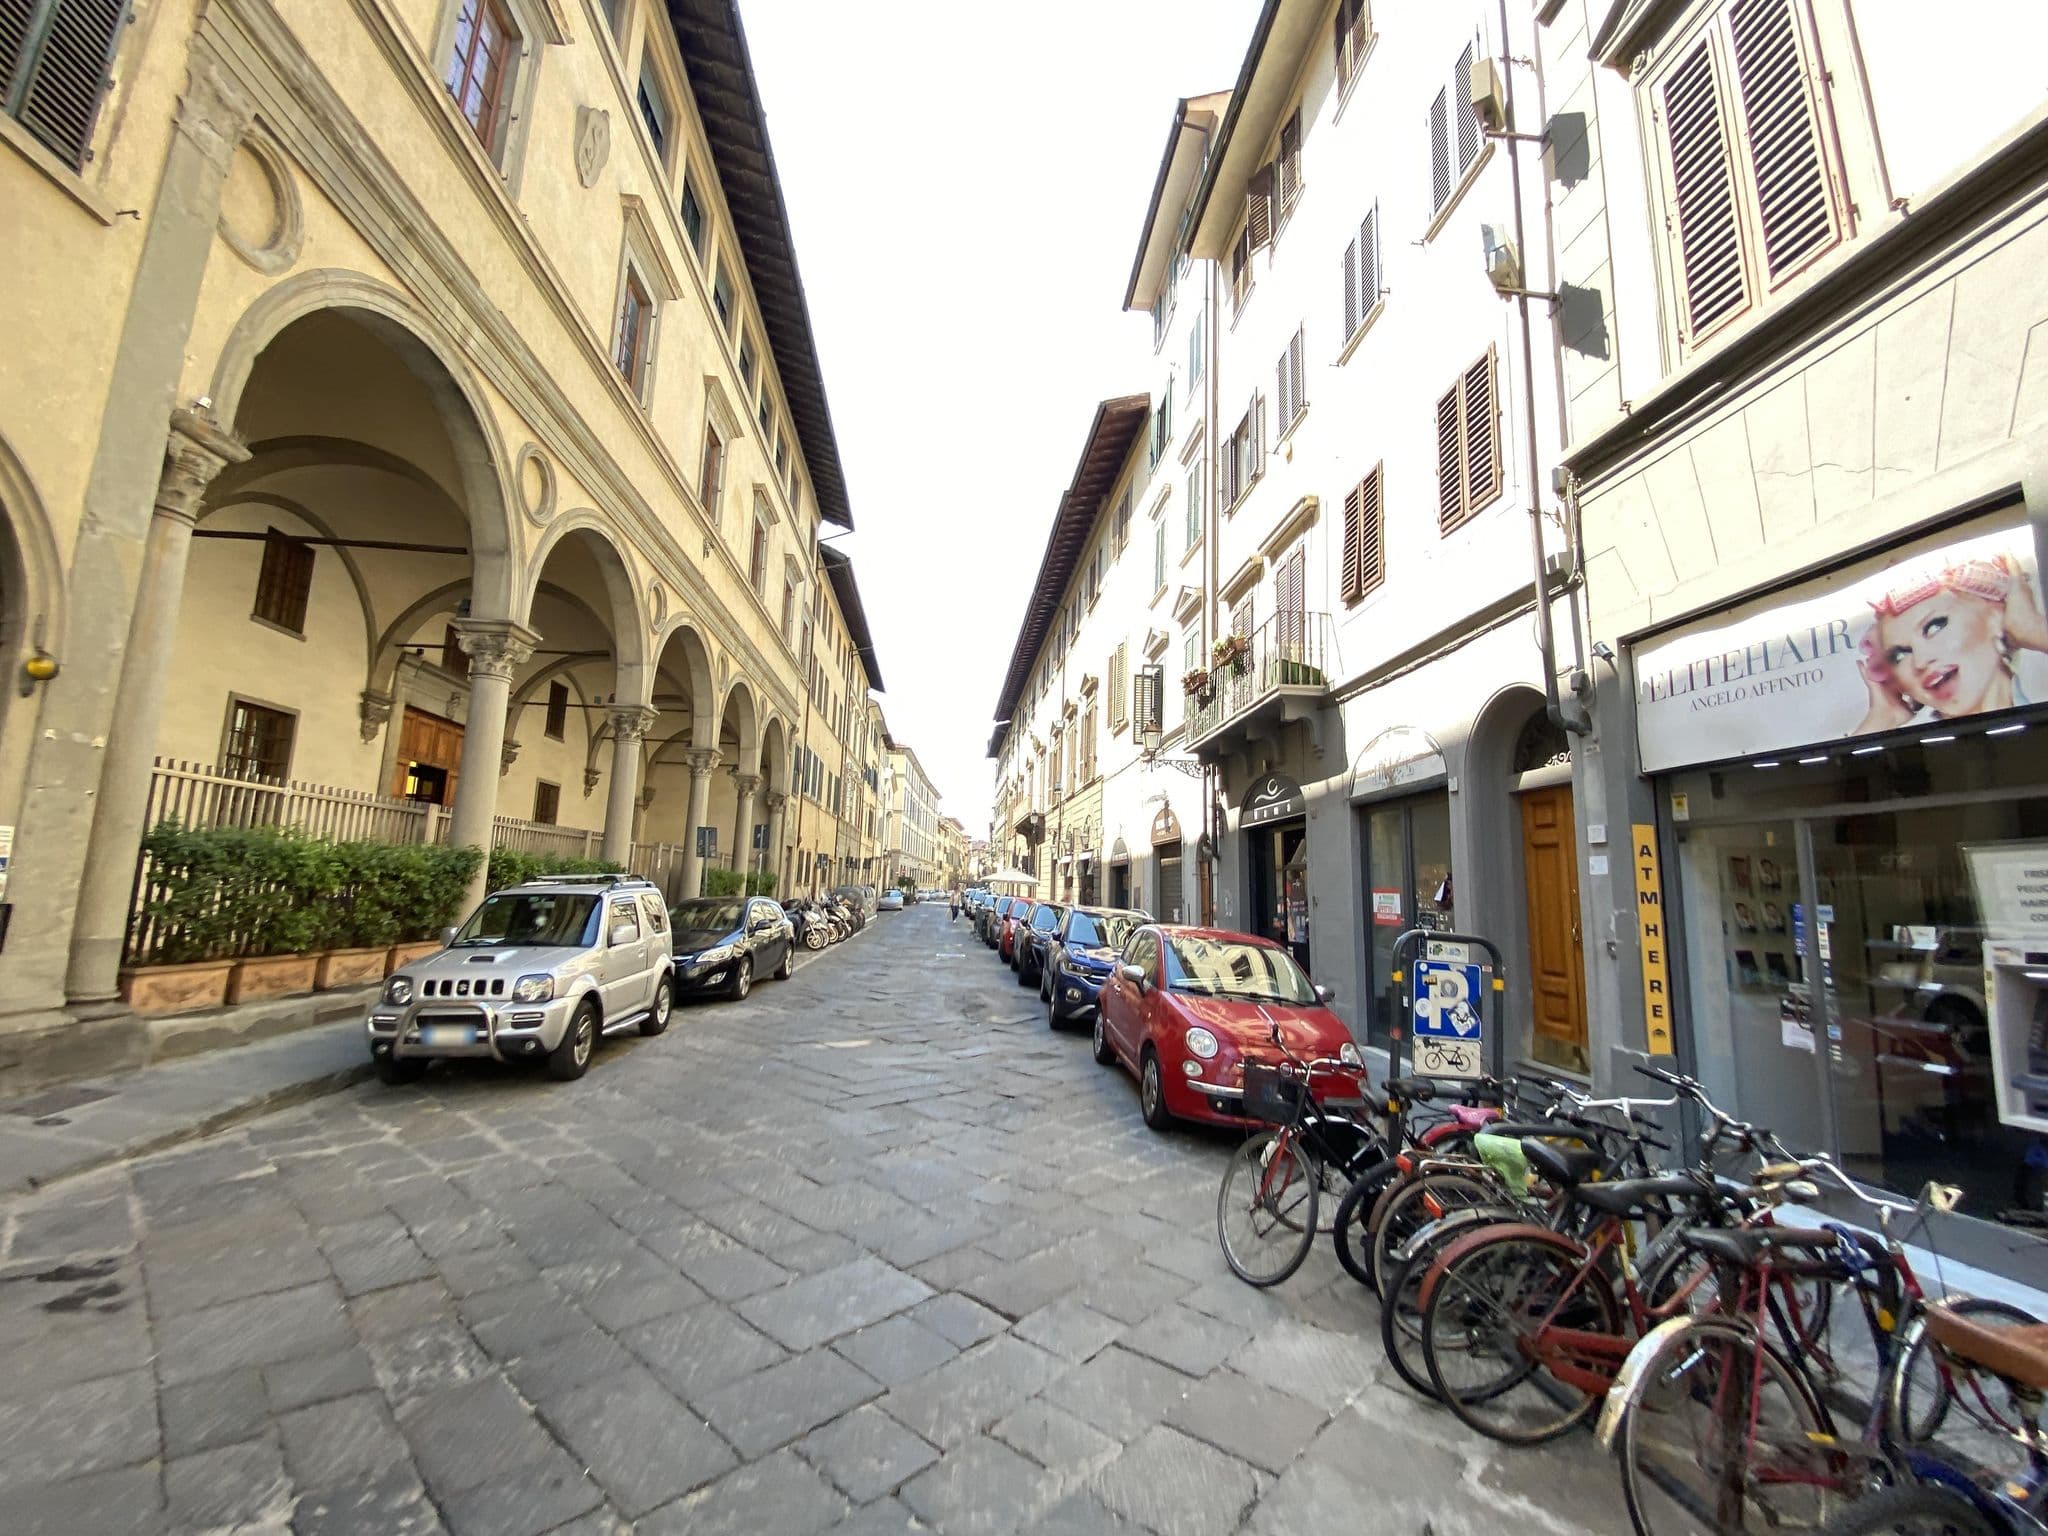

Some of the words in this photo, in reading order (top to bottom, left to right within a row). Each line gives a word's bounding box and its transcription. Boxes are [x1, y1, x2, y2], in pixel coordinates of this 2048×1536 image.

[1689, 687, 1746, 712] ANGELO
[1750, 668, 1824, 697] AFFINITO
[1639, 844, 1659, 905] ATM
[1429, 968, 1469, 1030] P
[1645, 923, 1664, 1019] HERE
